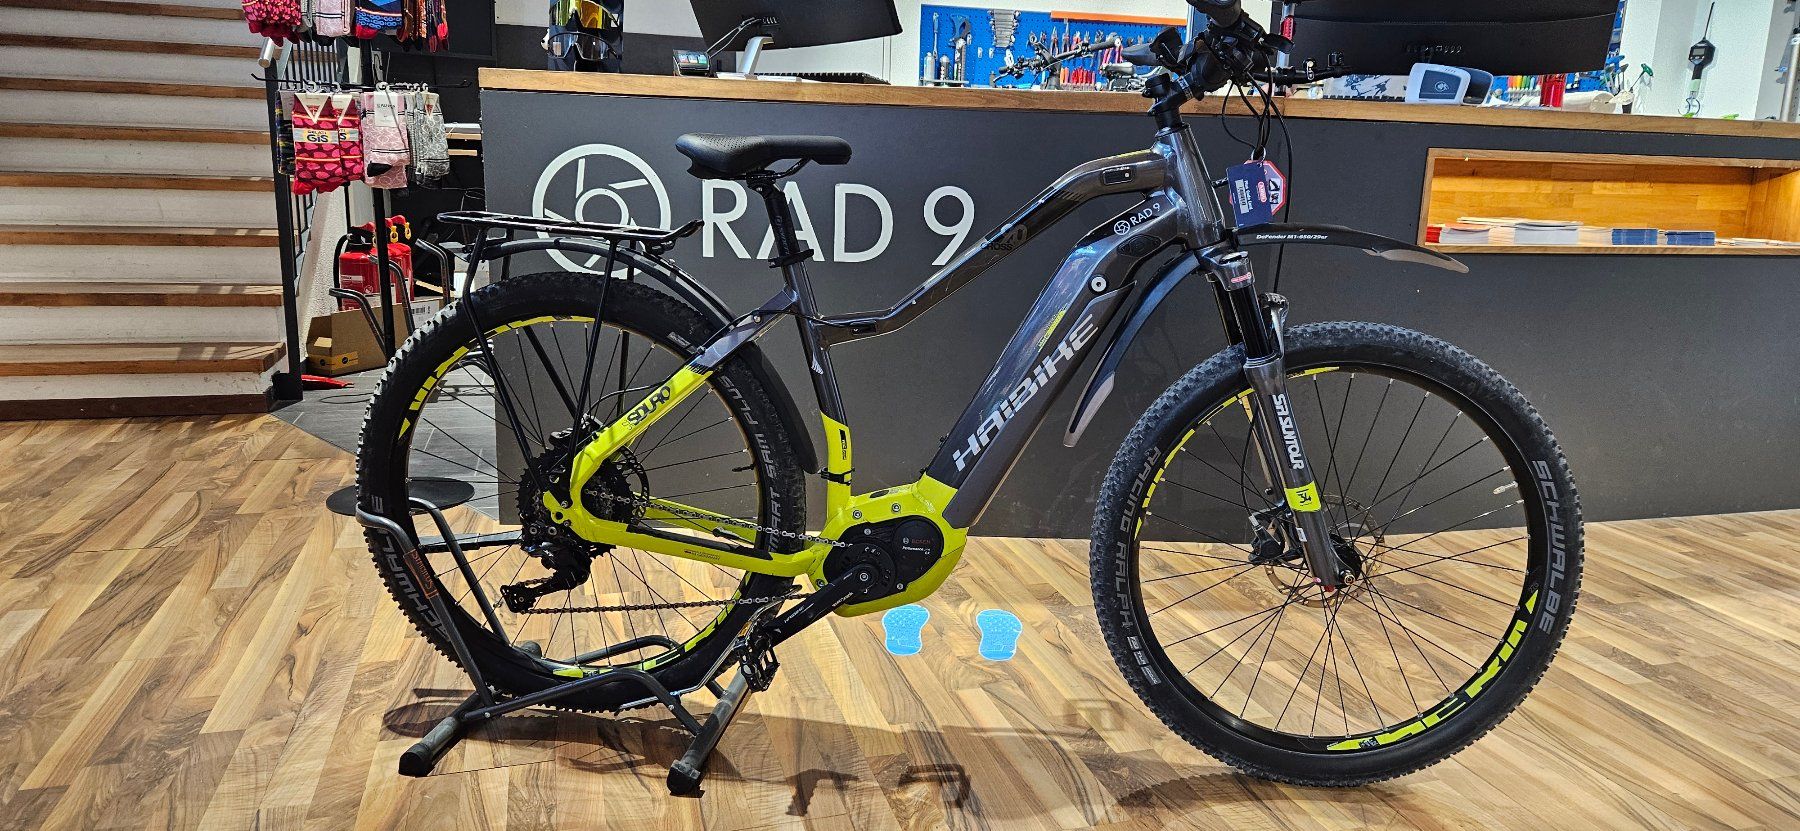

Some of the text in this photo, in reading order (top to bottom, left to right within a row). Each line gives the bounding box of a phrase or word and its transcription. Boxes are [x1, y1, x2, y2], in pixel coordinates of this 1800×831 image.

[702, 179, 894, 262] RAD
[923, 185, 975, 266] 9
[1129, 203, 1161, 226] RAD 9
[719, 375, 782, 552] MART SAM PLUS
[1279, 415, 1305, 470] SUNTOUR
[1114, 446, 1162, 631] RACING RALPH
[1532, 460, 1566, 635] SCHWALBE
